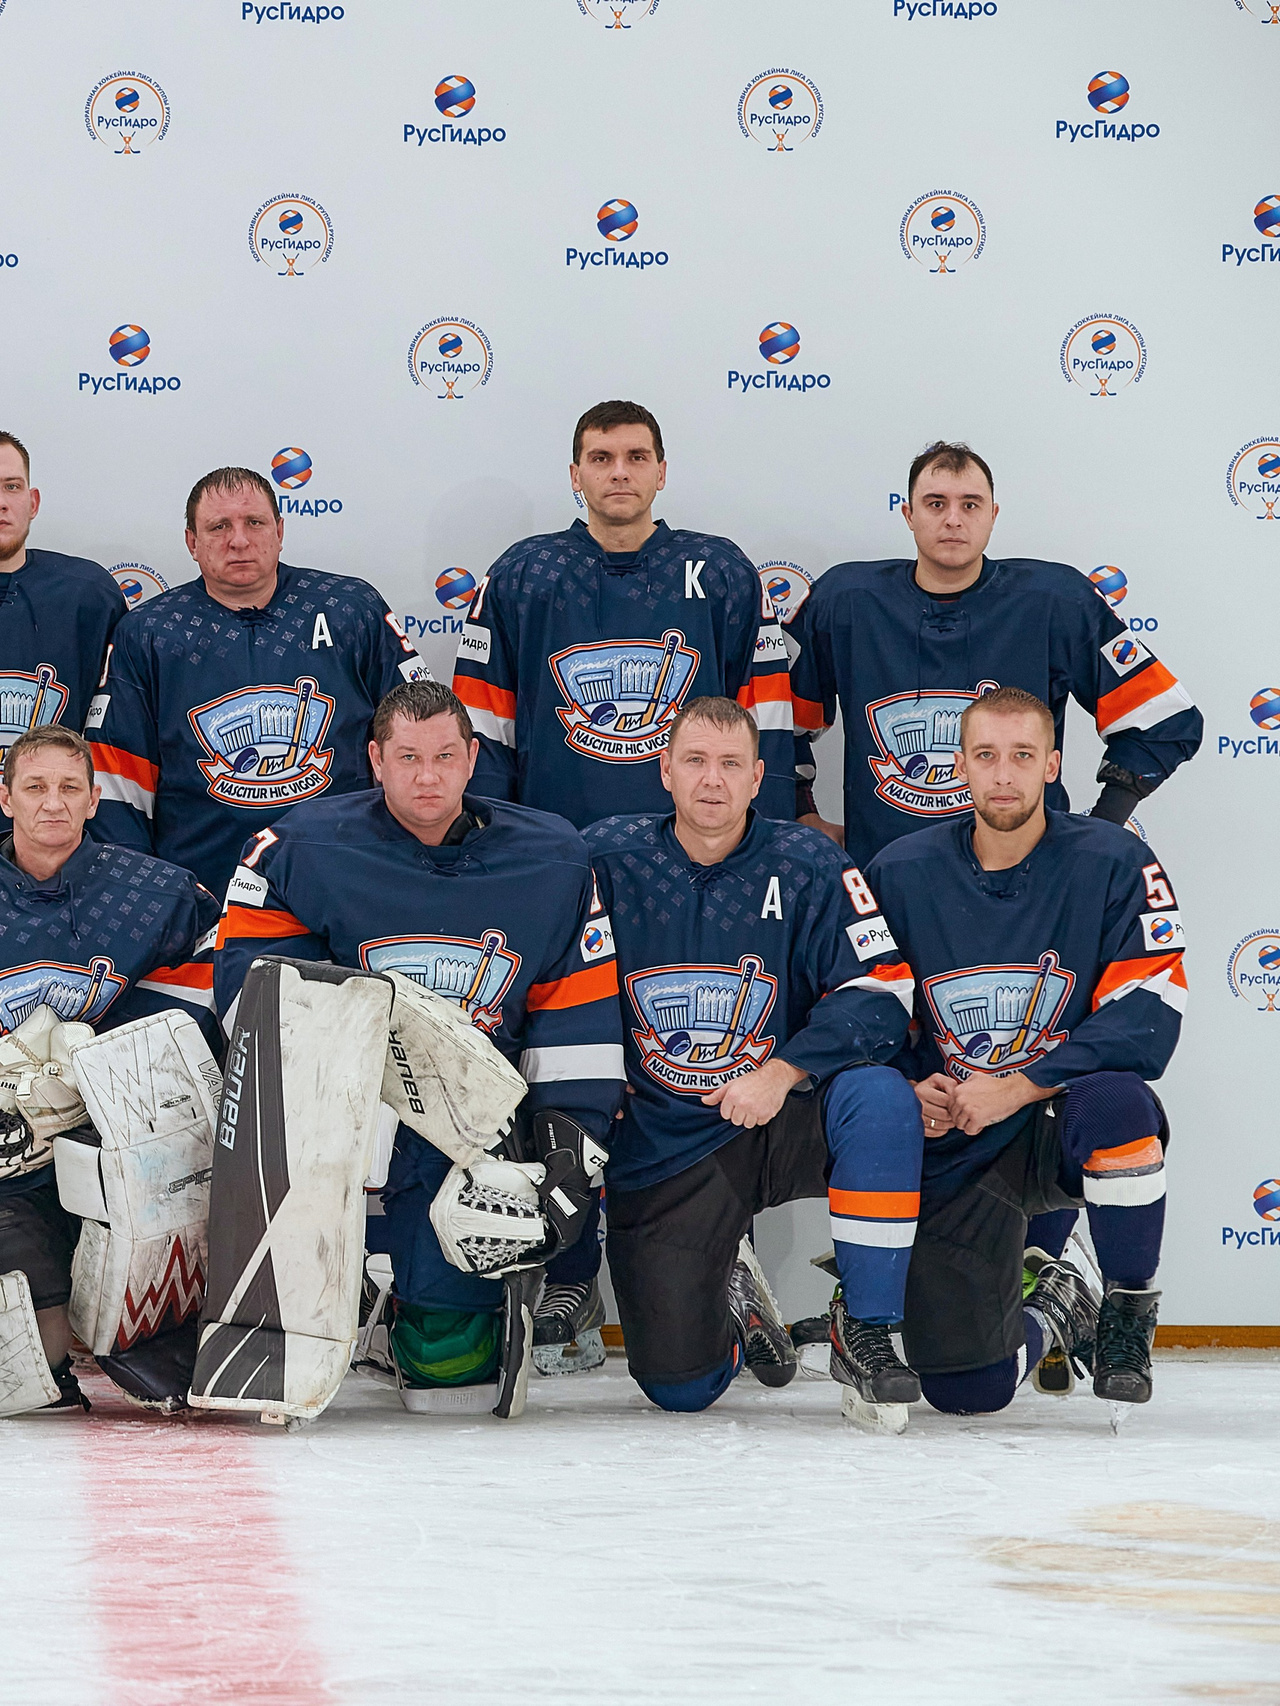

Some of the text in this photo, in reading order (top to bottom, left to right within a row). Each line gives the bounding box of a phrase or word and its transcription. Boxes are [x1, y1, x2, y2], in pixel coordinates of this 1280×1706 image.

[242, 2, 344, 24] РусГидро
[894, 0, 997, 20] РусГидро
[82, 69, 172, 142] КОРПОРАТИВНАЯ ХОККЕЙНАЯ ЛИГА ГРУППЫ РУСГИДРО
[735, 67, 825, 139] КОРПОРАТИВНАЯ ХОККЕЙНАЯ ЛИГА ГРУППЫ РУСГИДРО
[98, 116, 157, 129] РусГидро
[751, 113, 810, 126] РусГидро
[404, 124, 506, 146] РусГидро
[1056, 120, 1160, 142] РусГидро
[246, 192, 335, 264] КОРПОРАТИВНАЯ ХОККЕЙНАЯ ЛИГА ГРУППЫ РУСГИДРО
[898, 188, 987, 261] КОРПОРАТИВНАЯ ХОККЕЙНАЯ ЛИГА ГРУППЫ РУСГИДРО
[261, 238, 321, 251] РусГидро
[913, 235, 973, 248] РусГидро
[567, 248, 668, 269] РусГидро
[1223, 244, 1280, 266] РусГи
[405, 315, 495, 387] КОРПОРАТИВНАЯ ХОККЕЙНАЯ ЛИГА ГРУППЫ РУСГИДРО
[1058, 312, 1148, 385] КОРПОРАТИВНАЯ ХОККЕЙНАЯ ЛИГА ГРУППЫ РУСГИДРО
[421, 361, 480, 374] РусГидро
[1073, 358, 1133, 371] РусГидро
[79, 373, 180, 394] РусГидро
[728, 371, 830, 393] РусГидро
[1226, 436, 1279, 506] КОРПОРАТИВНАЯ ХОККЕЙНАЯ
[279, 495, 343, 517] Гидро
[685, 560, 706, 599] K
[312, 602, 333, 650] A
[404, 616, 463, 637] РусГи
[573, 730, 671, 754] NASCITUR HIC VIGO
[1219, 736, 1280, 758] РусГи
[216, 773, 324, 798] NASCITUR HIC VIGOR
[884, 783, 934, 807] NASCITUR
[936, 794, 954, 807] HIC
[842, 867, 879, 915] 8
[1142, 862, 1176, 909] 5
[760, 876, 783, 920] A
[1227, 928, 1279, 997] КОРПОРАТИВНАЯ ХОККЕЙНАЯ
[649, 1059, 697, 1086] NASCITUR
[700, 1074, 719, 1087] HIC
[589, 1154, 605, 1169] CC
[1223, 1227, 1280, 1249] РусГи
